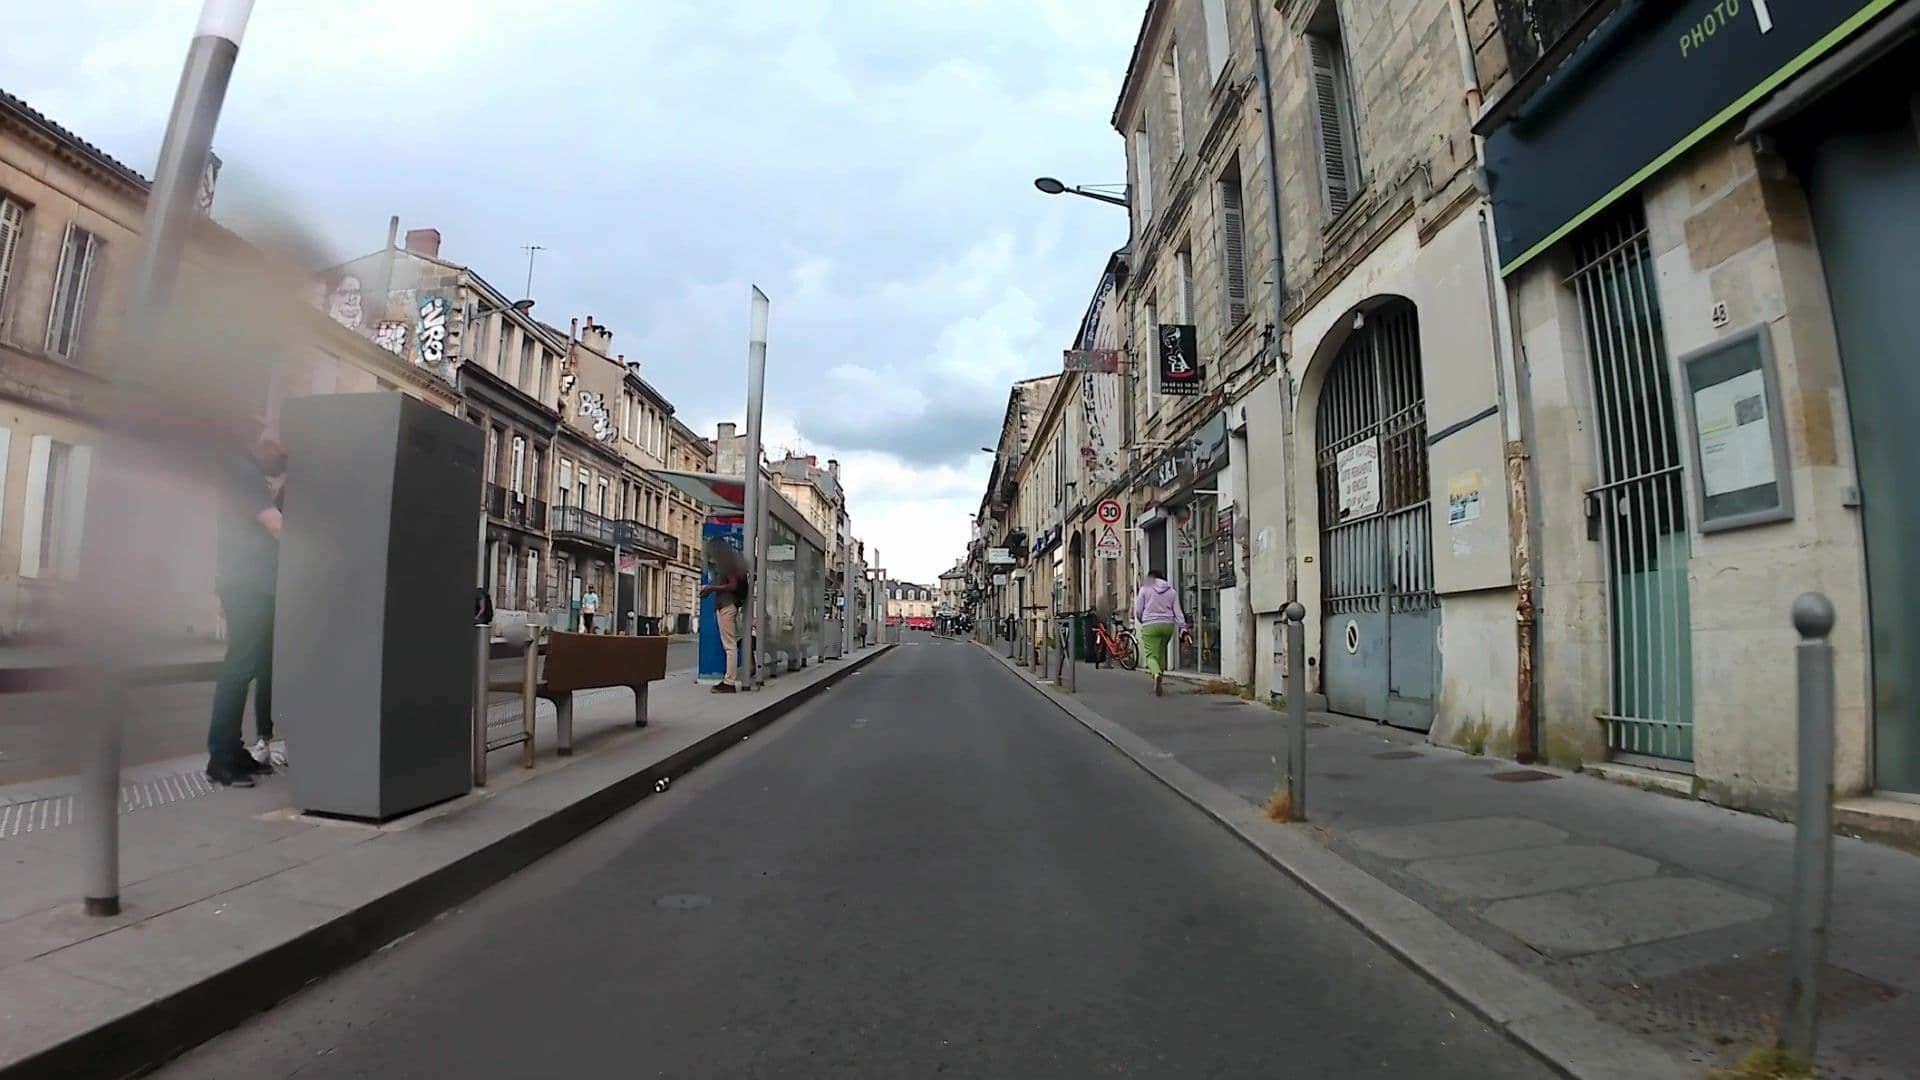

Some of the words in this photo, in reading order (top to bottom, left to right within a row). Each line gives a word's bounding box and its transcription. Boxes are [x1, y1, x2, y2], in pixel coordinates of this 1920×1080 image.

[1680, 0, 1739, 57] PHOTO
[1712, 304, 1727, 323] 48
[1103, 506, 1118, 518] 30
